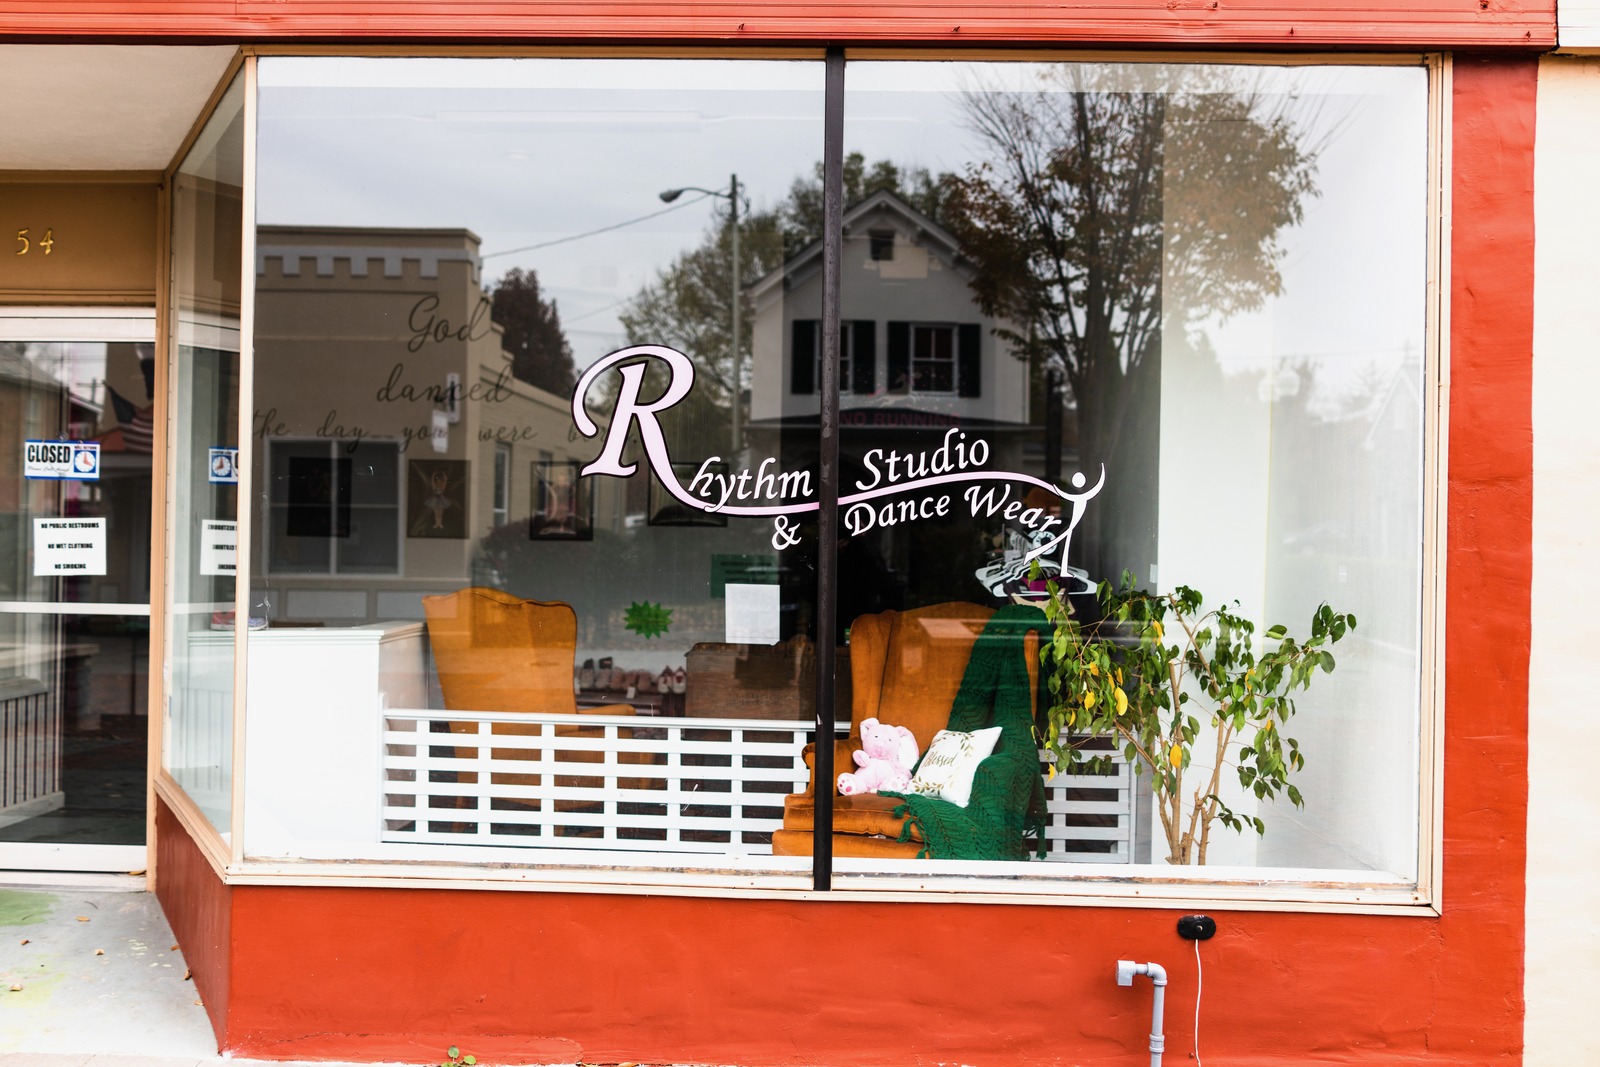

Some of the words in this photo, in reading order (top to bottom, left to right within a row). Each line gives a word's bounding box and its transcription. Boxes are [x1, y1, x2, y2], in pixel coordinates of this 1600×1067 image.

[407, 294, 490, 353] God
[376, 362, 514, 403] danced
[27, 445, 71, 463] CLOSED
[252, 408, 291, 439] the
[316, 410, 370, 454] day
[399, 424, 448, 454] you
[478, 425, 537, 442] were
[571, 343, 814, 517] Rhythm
[855, 427, 989, 491] Studio
[771, 514, 802, 551] &
[844, 494, 951, 538] Dance
[963, 483, 1062, 533] Wear
